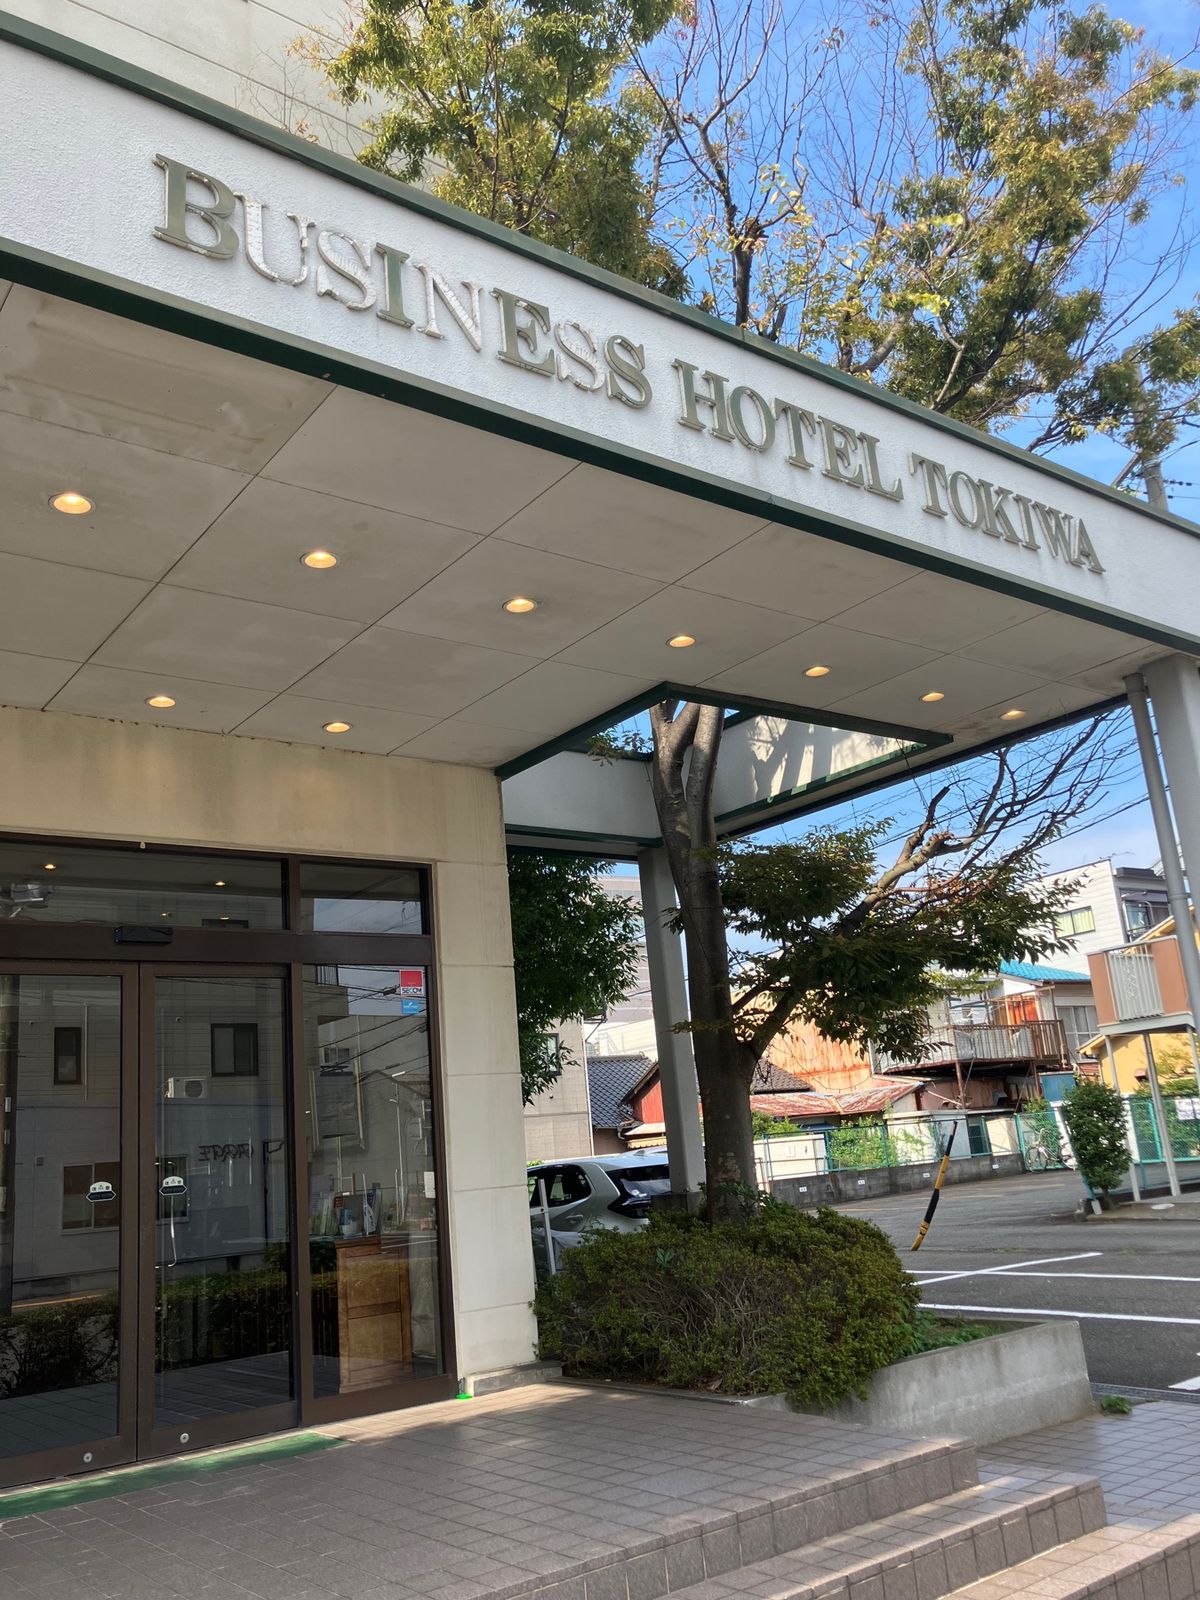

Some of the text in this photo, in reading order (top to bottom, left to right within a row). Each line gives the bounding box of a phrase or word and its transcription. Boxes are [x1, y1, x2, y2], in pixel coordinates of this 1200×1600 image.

[152, 153, 1106, 574] BUSINESS HOTEL TOKIWA
